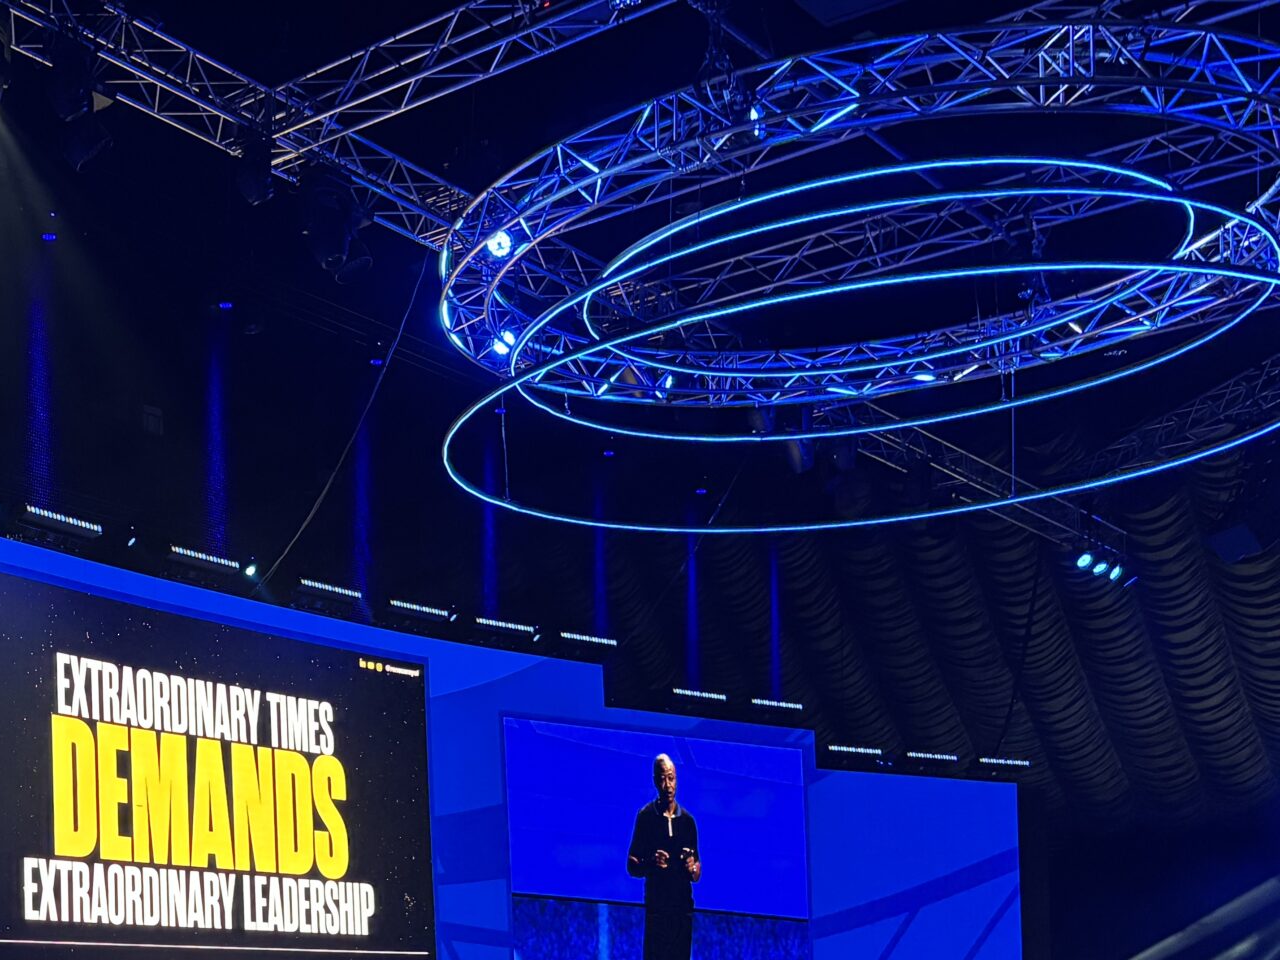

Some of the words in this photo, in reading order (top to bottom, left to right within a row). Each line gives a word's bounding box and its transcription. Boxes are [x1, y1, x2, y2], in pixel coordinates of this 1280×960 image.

[55, 651, 261, 744] EXTRAORDINARY
[265, 692, 335, 755] TIMES
[51, 713, 349, 880] DEMANDS
[23, 857, 237, 930] EXTRAORDINARY
[241, 875, 376, 936] LEADERSHIP
